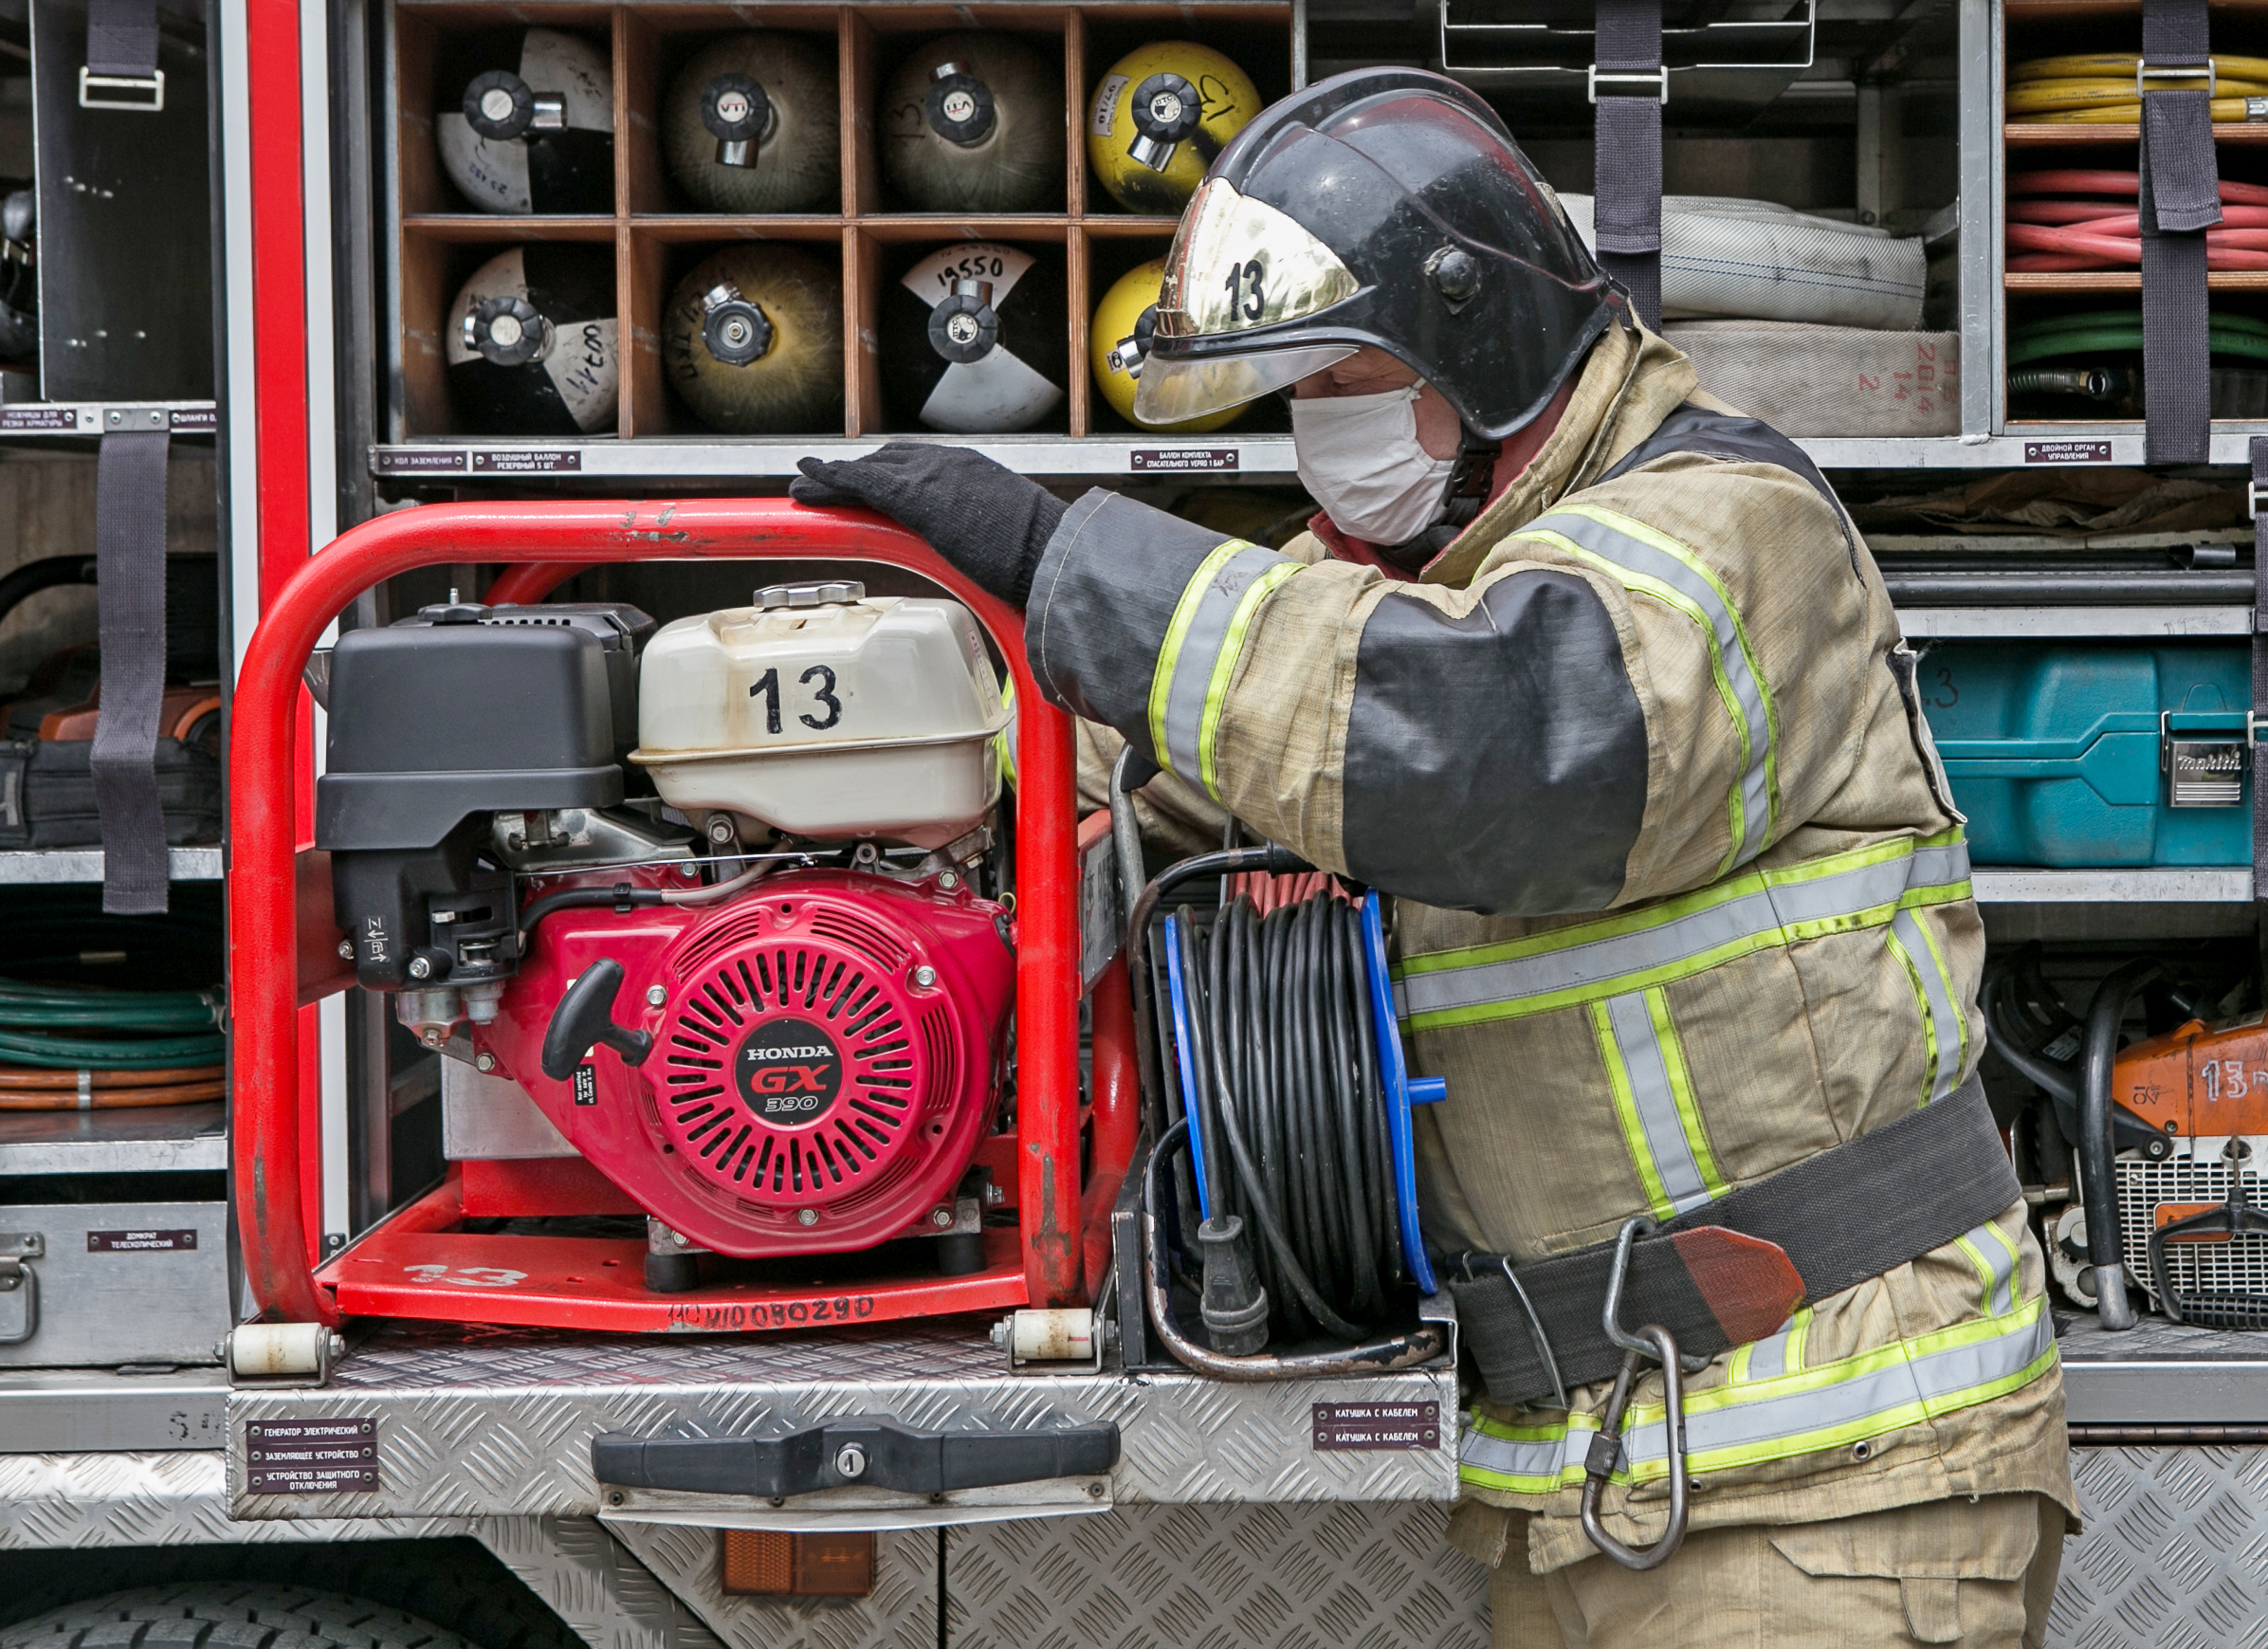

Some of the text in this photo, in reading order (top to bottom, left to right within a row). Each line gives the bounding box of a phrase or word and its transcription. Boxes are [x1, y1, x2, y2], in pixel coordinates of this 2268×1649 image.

[1224, 259, 1265, 322] 13
[1858, 373, 1880, 392] 2
[1917, 342, 1935, 414] 2014
[1893, 372, 1912, 400] 14
[180, 412, 208, 423] ШЛАНГИ
[2041, 443, 2073, 452] ДВОЙНОЙ
[491, 452, 533, 462] ВОЗДУШНЫЙ
[1159, 451, 1180, 460] БАЛЛОН
[2048, 452, 2090, 461] УПРАВЛЕНИЯ
[497, 461, 536, 470] РЕЗЕРВНЫЙ
[1213, 459, 1225, 467] БАР
[749, 664, 843, 735] 13
[747, 1045, 834, 1061] HONDA
[750, 1063, 832, 1094] GX
[764, 1095, 819, 1112] 390
[125, 1232, 157, 1240] ДОМКРАТ
[110, 1238, 174, 1249] ТЕЛЕСКОПИЧЕСКИЙ
[1335, 1408, 1418, 1418] КАТУШКА С КАБЕЛЕМ
[264, 1424, 358, 1437] ГЕНЕРАТОР ЭЛЕКТРИЧЕСКИЙ
[1335, 1432, 1418, 1442] КАТУШКА С КАБЕЛЕМ
[265, 1449, 359, 1461] ЗАЗЕМЛЯЮЩЕЕ УСТРОЙСТВО
[266, 1470, 360, 1481] УСТРОЙСТВО ЗАЩИТНОГО
[289, 1480, 338, 1491] ОТКЛЮЧЕНИЯ
